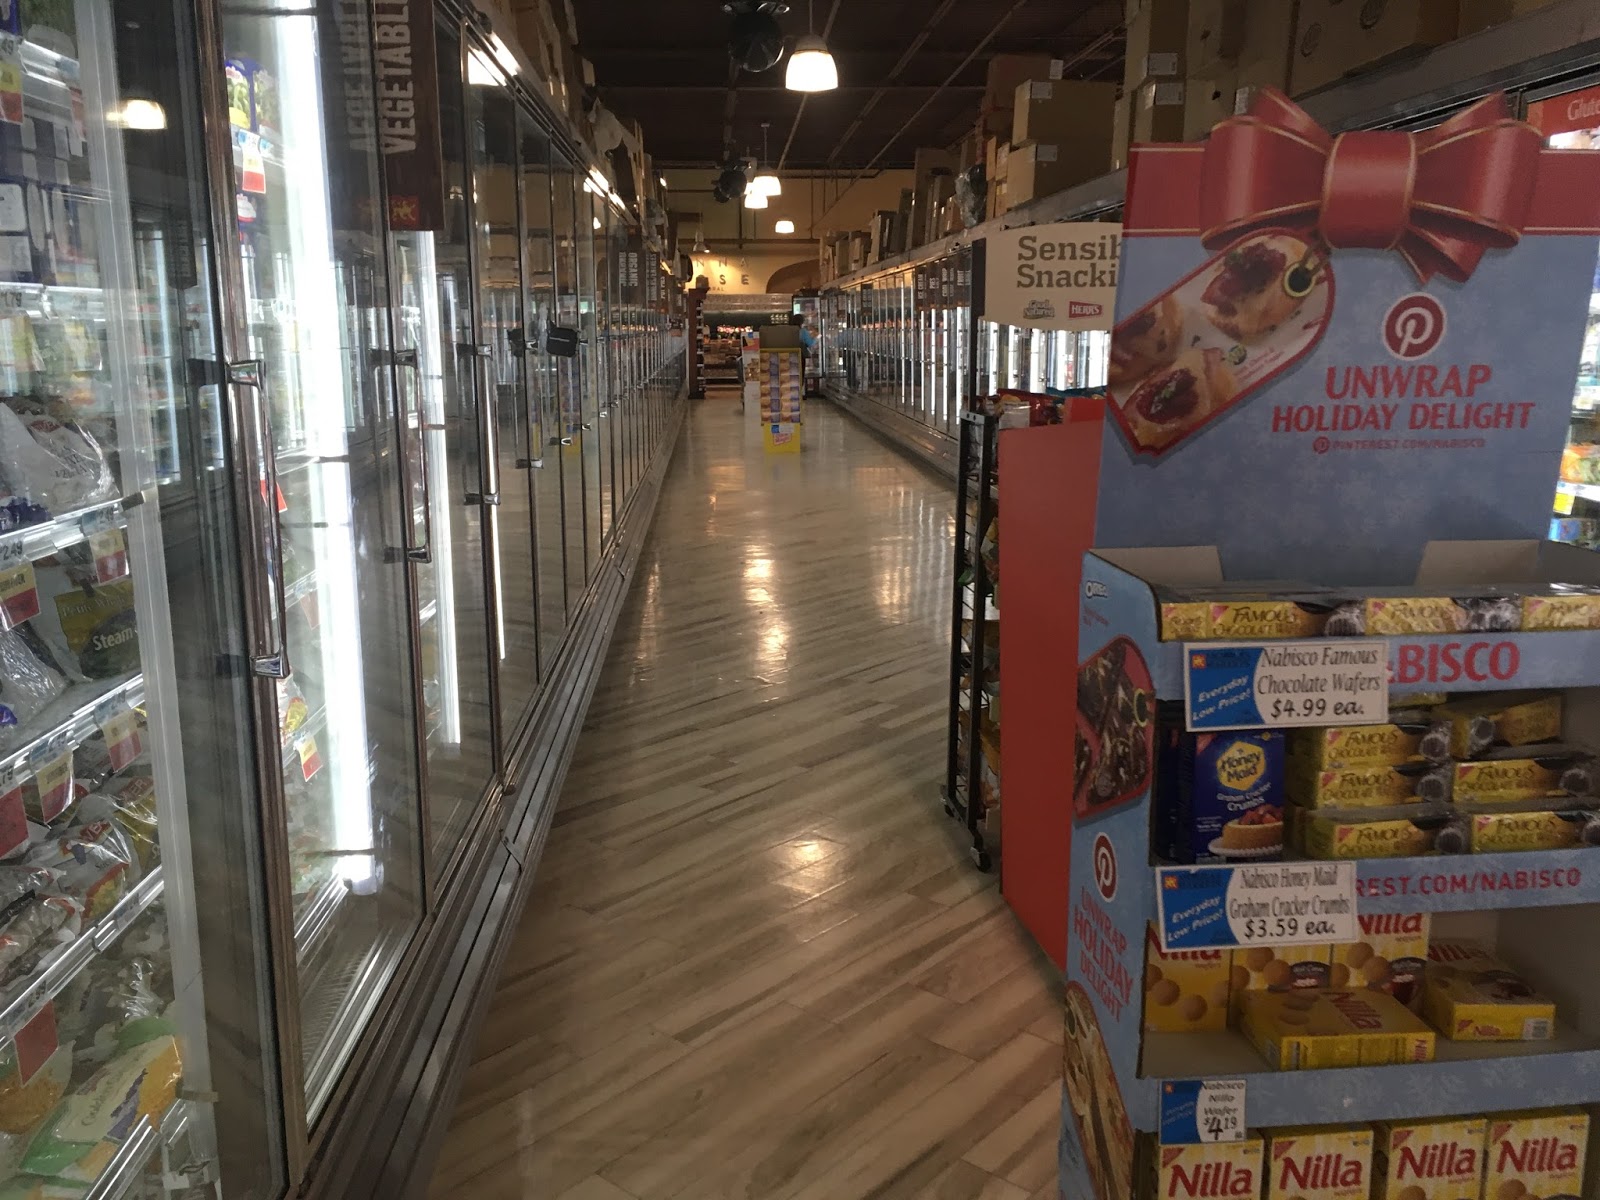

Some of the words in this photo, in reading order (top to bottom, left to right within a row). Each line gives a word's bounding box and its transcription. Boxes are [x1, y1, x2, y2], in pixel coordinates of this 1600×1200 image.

[376, 0, 416, 154] VEGETABL
[628, 252, 638, 287] ORGANIC
[1325, 364, 1492, 401] UNWRAP
[1271, 404, 1398, 433] HOLIDAY
[1408, 402, 1536, 430] DELIGHT
[92, 627, 134, 652] Steam
[1261, 648, 1319, 668] Nabisco
[1321, 647, 1379, 667] Famous
[1198, 675, 1249, 703] Everyday
[1257, 673, 1328, 695] Chocolate
[1332, 671, 1382, 695] Wafers
[1270, 697, 1327, 720] $4.99
[1333, 701, 1365, 717] ea.
[1221, 752, 1260, 772] Honey
[1227, 763, 1258, 782] Maid
[1240, 869, 1279, 889] Nabisco
[1281, 867, 1311, 891] Honey
[1313, 866, 1338, 887] Maid
[1081, 884, 1129, 956] UNWRAP
[1172, 896, 1221, 924] Everyday
[1229, 897, 1270, 919] Graham
[1272, 896, 1310, 917] Cracker
[1312, 894, 1351, 916] Crumbs
[1244, 917, 1299, 940] $3.59
[1305, 919, 1336, 936] ea.
[1073, 903, 1134, 1008] HOLIDAY
[1079, 949, 1124, 1025] DELIGHT
[1396, 1141, 1477, 1180] Nilla
[1496, 1136, 1578, 1174] Nilla
[1168, 1160, 1254, 1198] Nilla
[1278, 1152, 1364, 1191] Nilla
